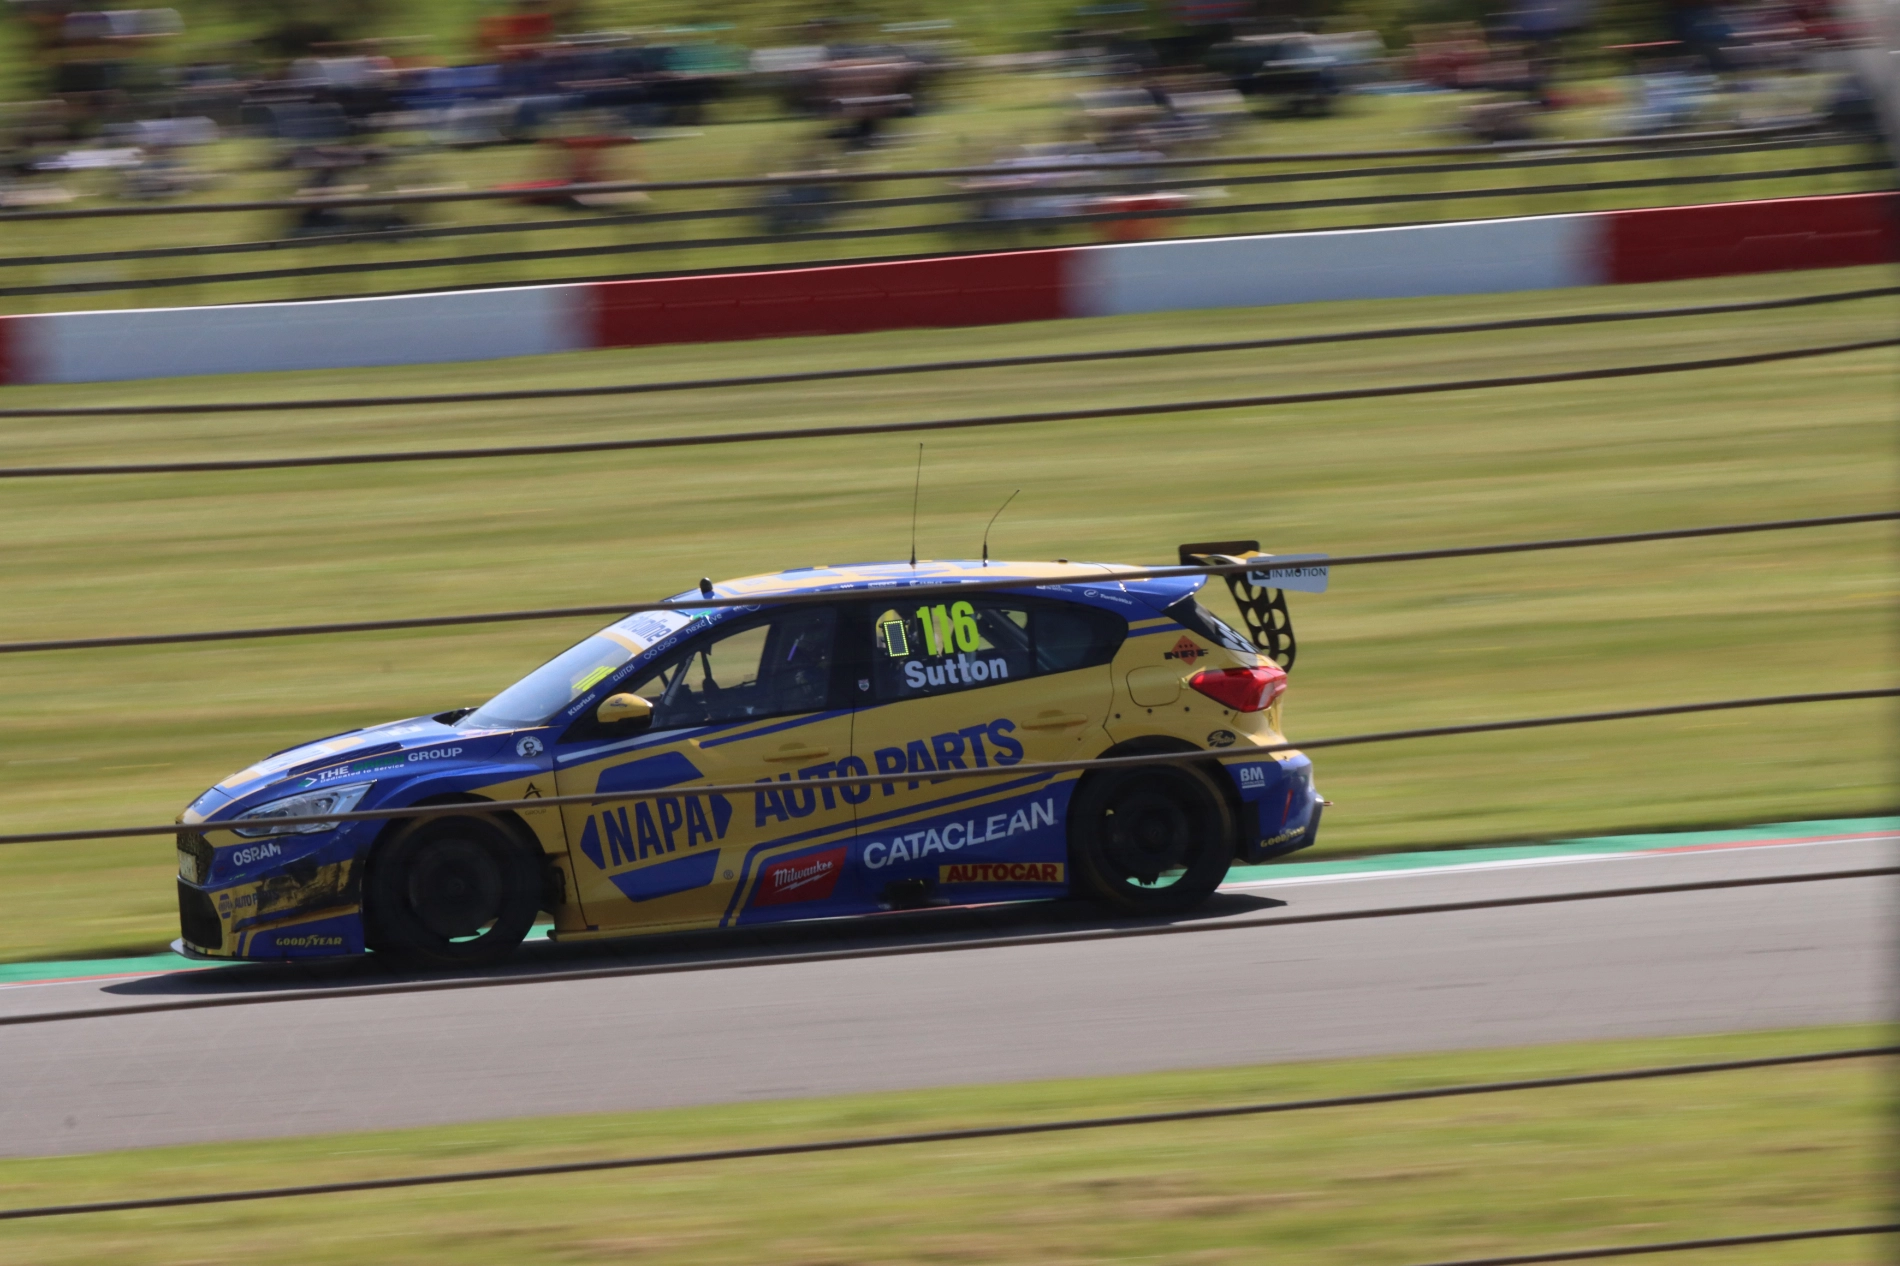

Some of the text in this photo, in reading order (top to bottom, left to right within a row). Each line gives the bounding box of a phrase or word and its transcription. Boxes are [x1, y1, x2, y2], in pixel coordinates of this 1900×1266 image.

[1272, 567, 1327, 578] IN MOTION
[916, 600, 980, 656] 116
[1164, 648, 1210, 661] NRF
[612, 663, 636, 682] CLUTCH
[904, 653, 1009, 689] Sutton
[567, 692, 596, 717] Klarius
[318, 747, 463, 780] THE GREEN GROUP
[320, 770, 361, 783] Dedicated
[374, 763, 405, 773] Service
[755, 718, 1025, 827] AUTO PARTS
[1240, 766, 1265, 782] BM
[602, 791, 714, 868] NAPA
[863, 798, 1054, 870] CATACLEAN
[233, 842, 282, 867] OSRAM
[772, 860, 834, 887] Milwaukee
[946, 863, 1059, 883] AUTOCAR
[234, 894, 252, 909] AUTO
[275, 934, 343, 948] GOODYEAR
